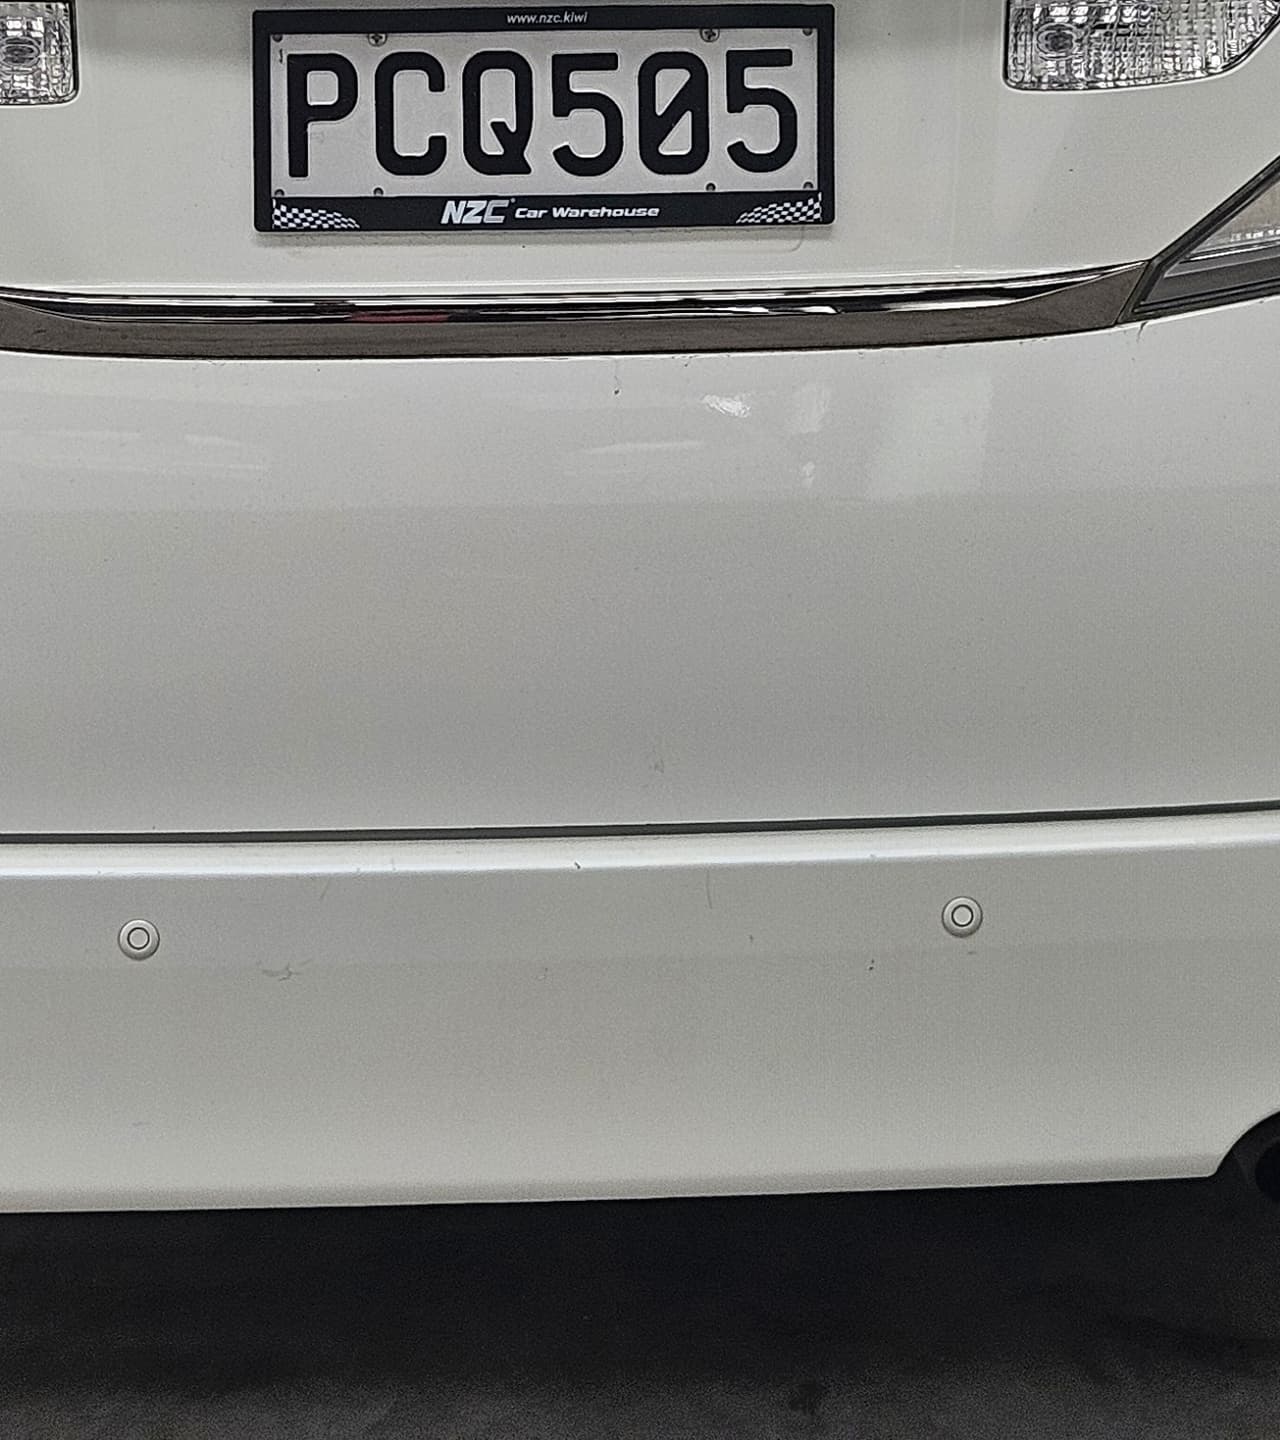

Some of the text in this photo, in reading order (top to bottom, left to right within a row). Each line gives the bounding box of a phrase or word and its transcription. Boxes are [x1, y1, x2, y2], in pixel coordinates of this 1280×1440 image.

[506, 10, 588, 25] www.nzc.kiwi
[286, 48, 798, 178] PCQ505
[440, 199, 660, 225] NZC Car Warehouse
